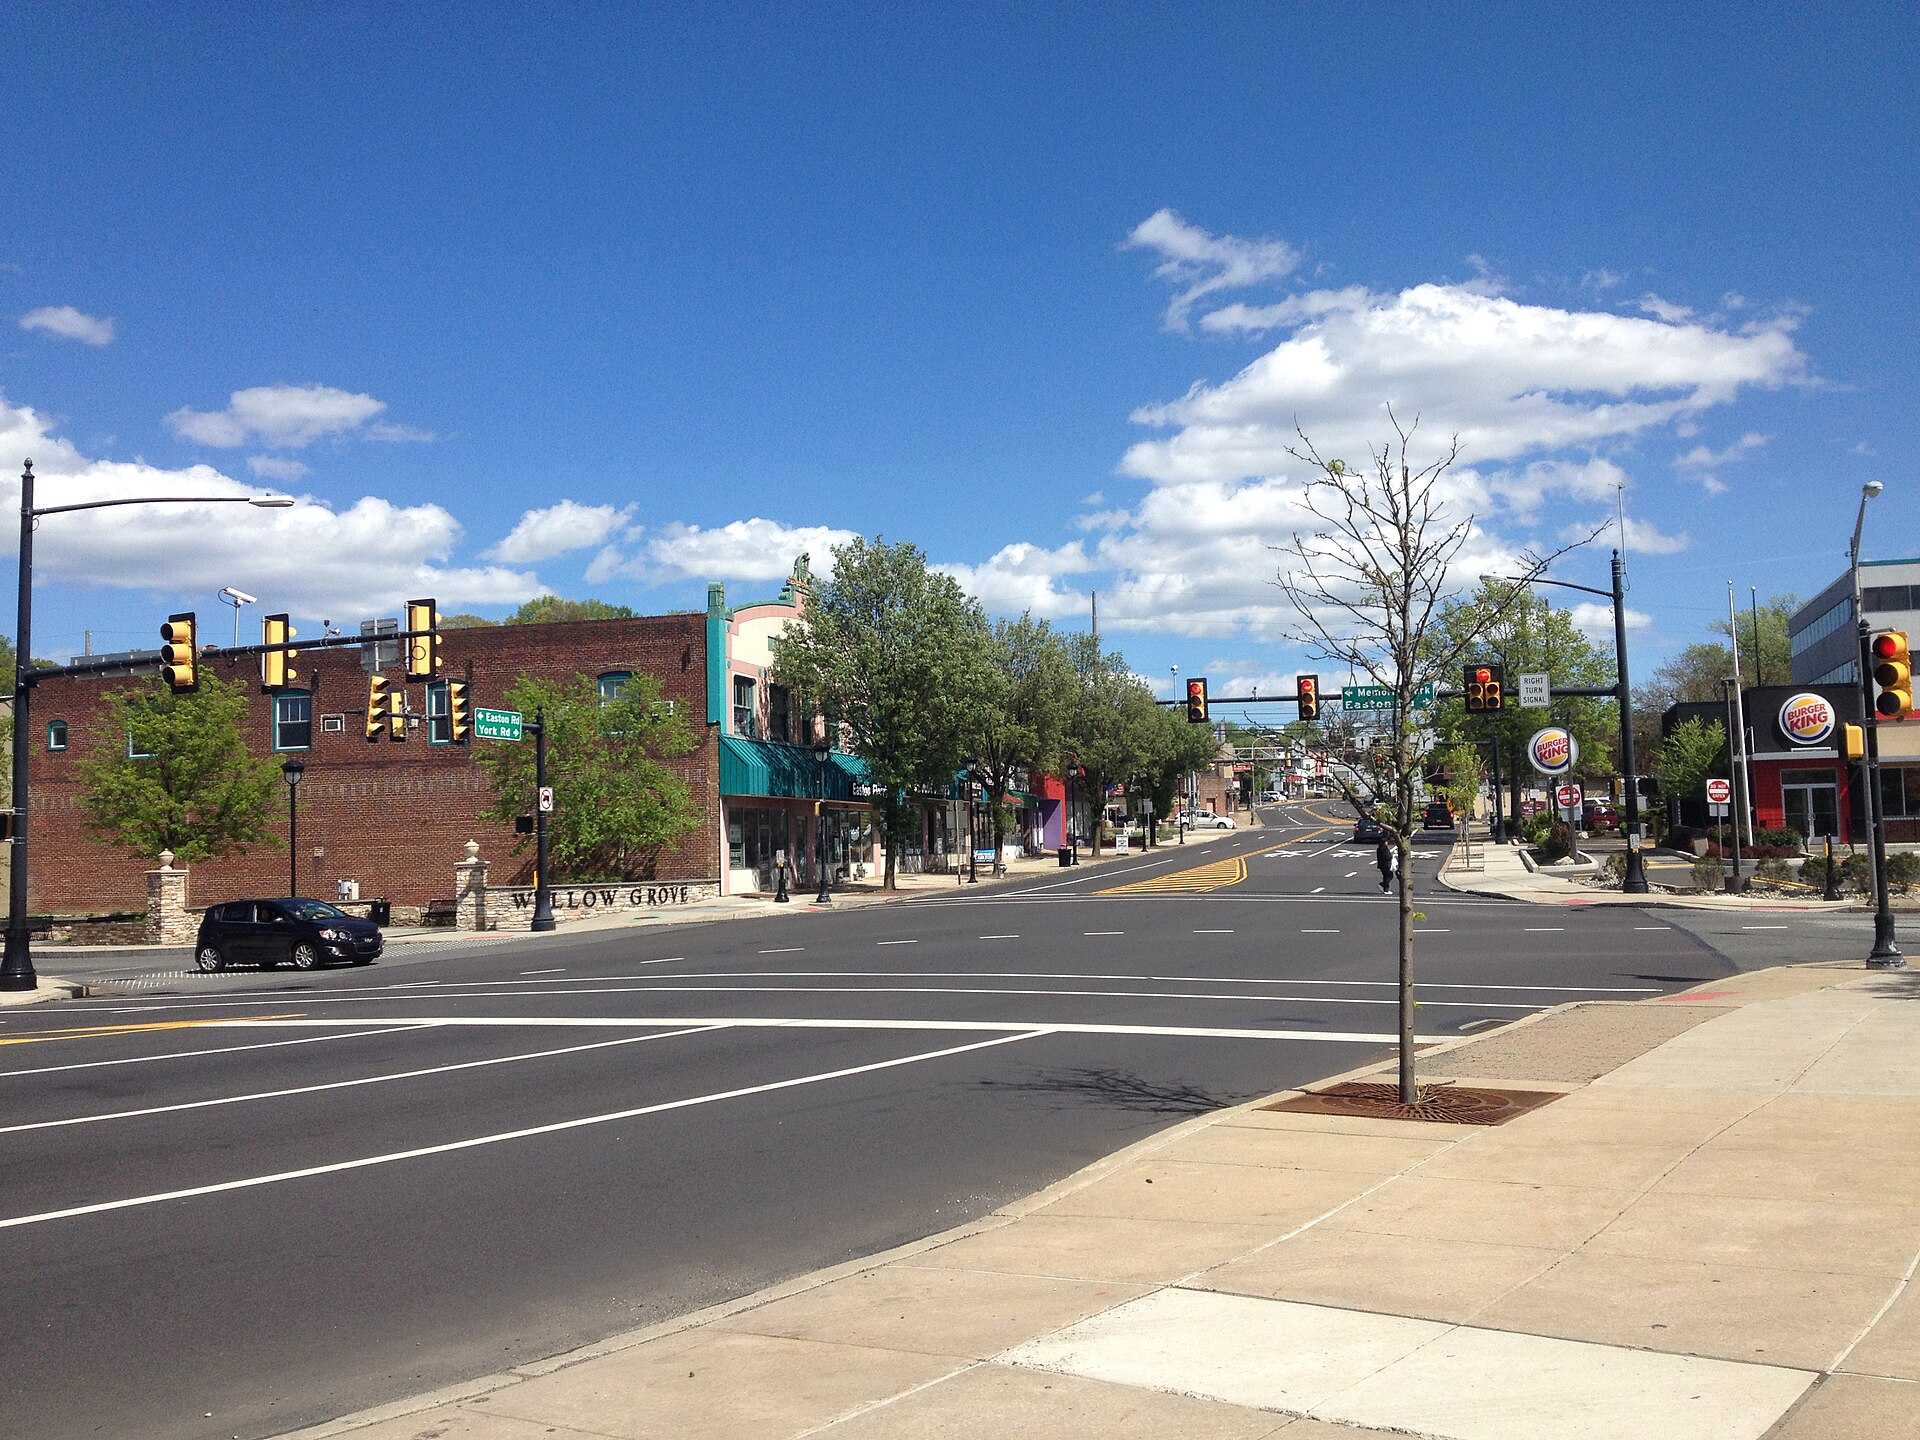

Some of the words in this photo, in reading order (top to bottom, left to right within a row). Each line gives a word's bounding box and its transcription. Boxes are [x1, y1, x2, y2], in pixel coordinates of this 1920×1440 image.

[1525, 686, 1543, 694] TURN
[1345, 700, 1392, 710] Easton
[1523, 696, 1546, 704] SIGNAL
[486, 712, 510, 724] Easton
[511, 715, 520, 725] Rd
[1787, 703, 1826, 721] BURGER
[1790, 711, 1828, 733] KING
[479, 725, 497, 736] York
[500, 727, 511, 737] Rd
[1539, 745, 1568, 761] KING
[512, 889, 617, 909] WLLOW
[630, 886, 688, 906] GROVE
